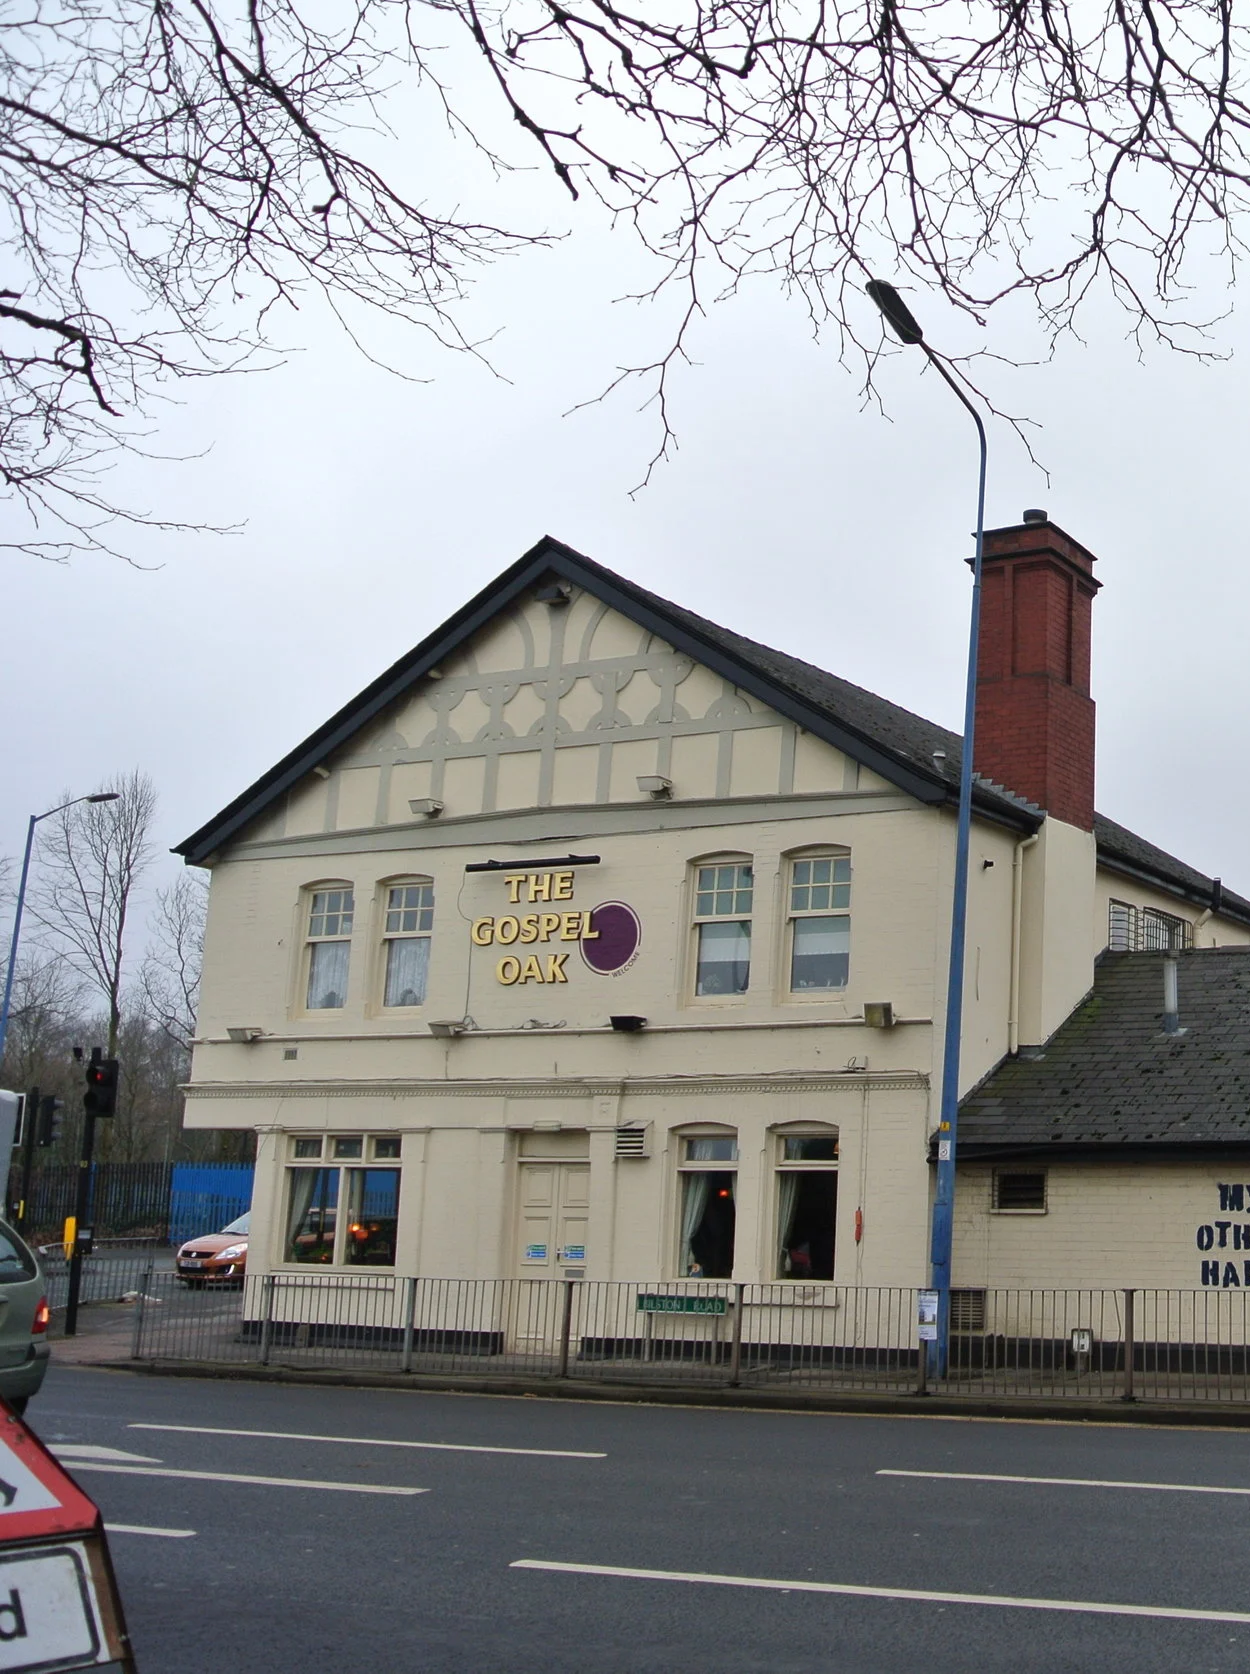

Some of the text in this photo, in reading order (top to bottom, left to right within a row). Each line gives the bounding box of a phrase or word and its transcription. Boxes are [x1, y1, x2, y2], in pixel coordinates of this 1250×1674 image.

[504, 871, 574, 903] THE
[471, 911, 601, 945] GOSPEL
[496, 953, 569, 985] OAK
[611, 950, 641, 978] WELCOME
